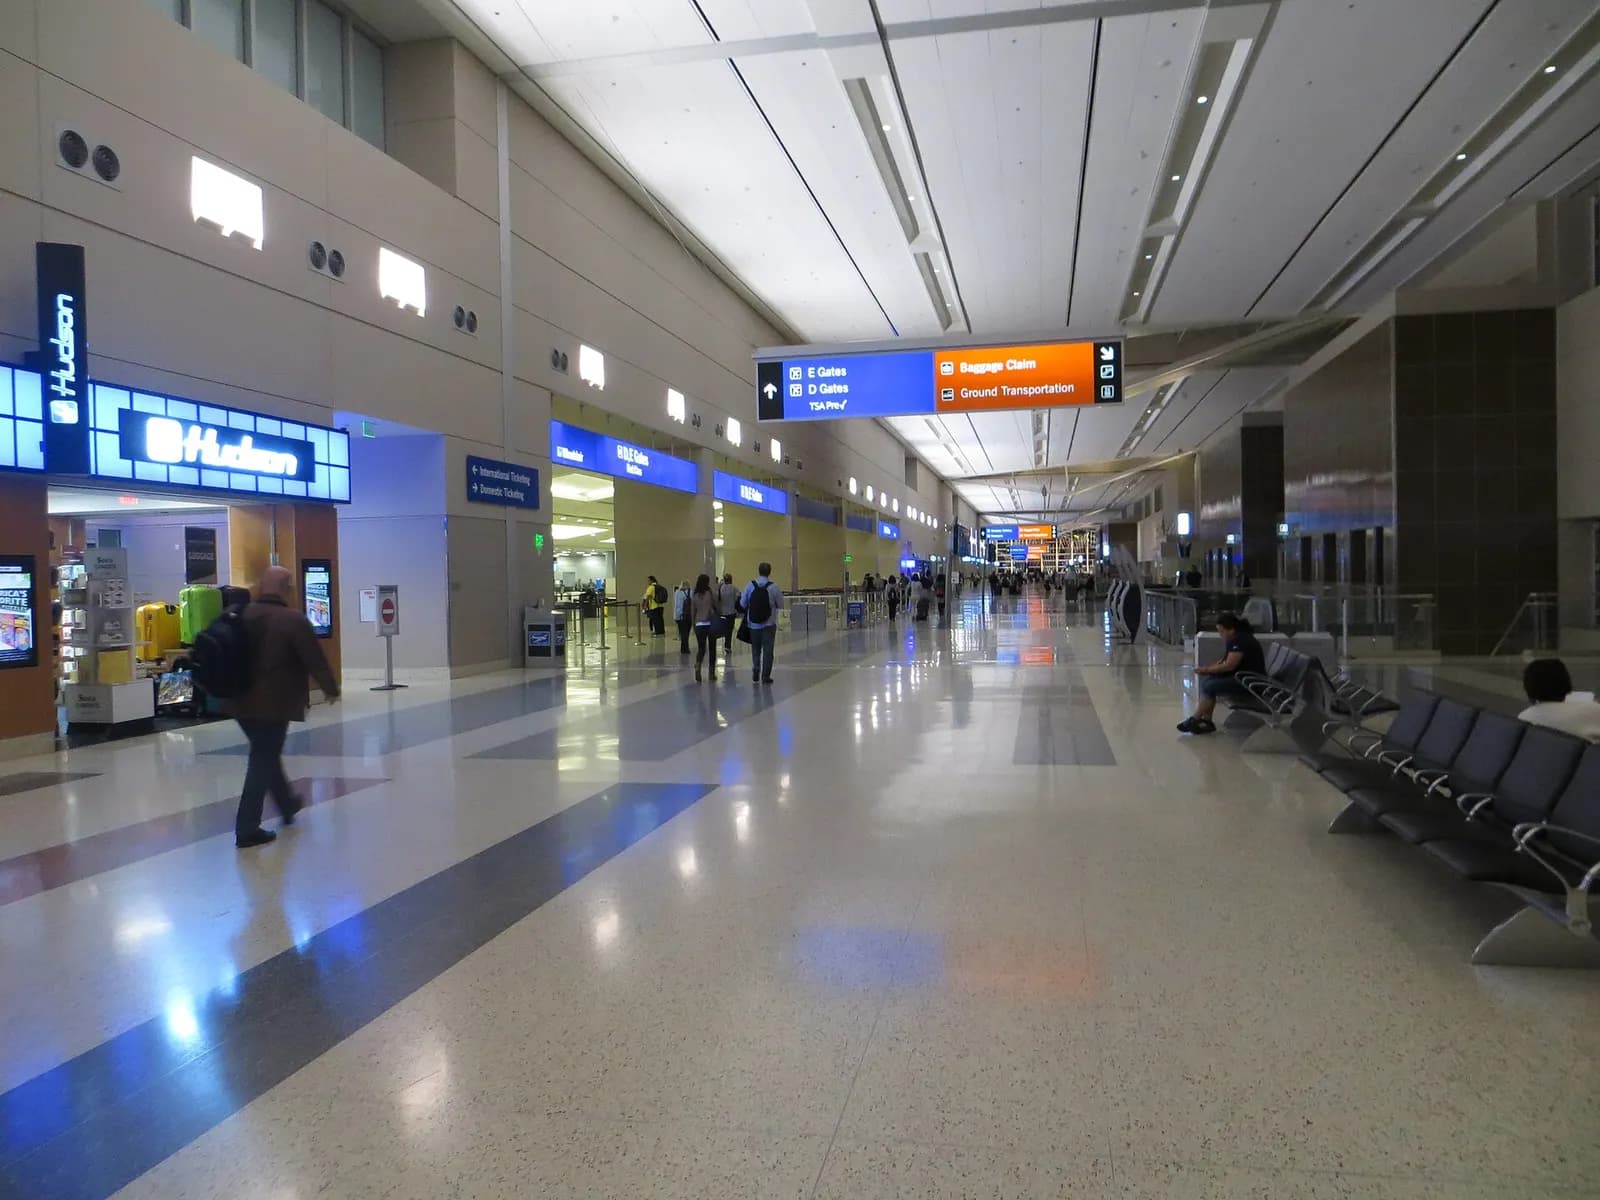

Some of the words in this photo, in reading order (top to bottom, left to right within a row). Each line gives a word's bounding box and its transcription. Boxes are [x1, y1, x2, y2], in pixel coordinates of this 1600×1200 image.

[49, 292, 77, 398] Hudson
[808, 368, 815, 378] E
[817, 366, 847, 378] Gates
[959, 360, 1003, 375] Baggage
[1005, 358, 1037, 371] Claim
[808, 384, 817, 395] D
[819, 383, 849, 394] Gates
[960, 386, 998, 399] Ground
[1000, 383, 1075, 397] Transportation
[808, 401, 825, 411] TSA
[182, 424, 298, 476] Hudson
[480, 465, 510, 481] International
[511, 472, 531, 487] Ticketing
[480, 484, 503, 497] Domestic
[504, 487, 525, 502] Ticketing
